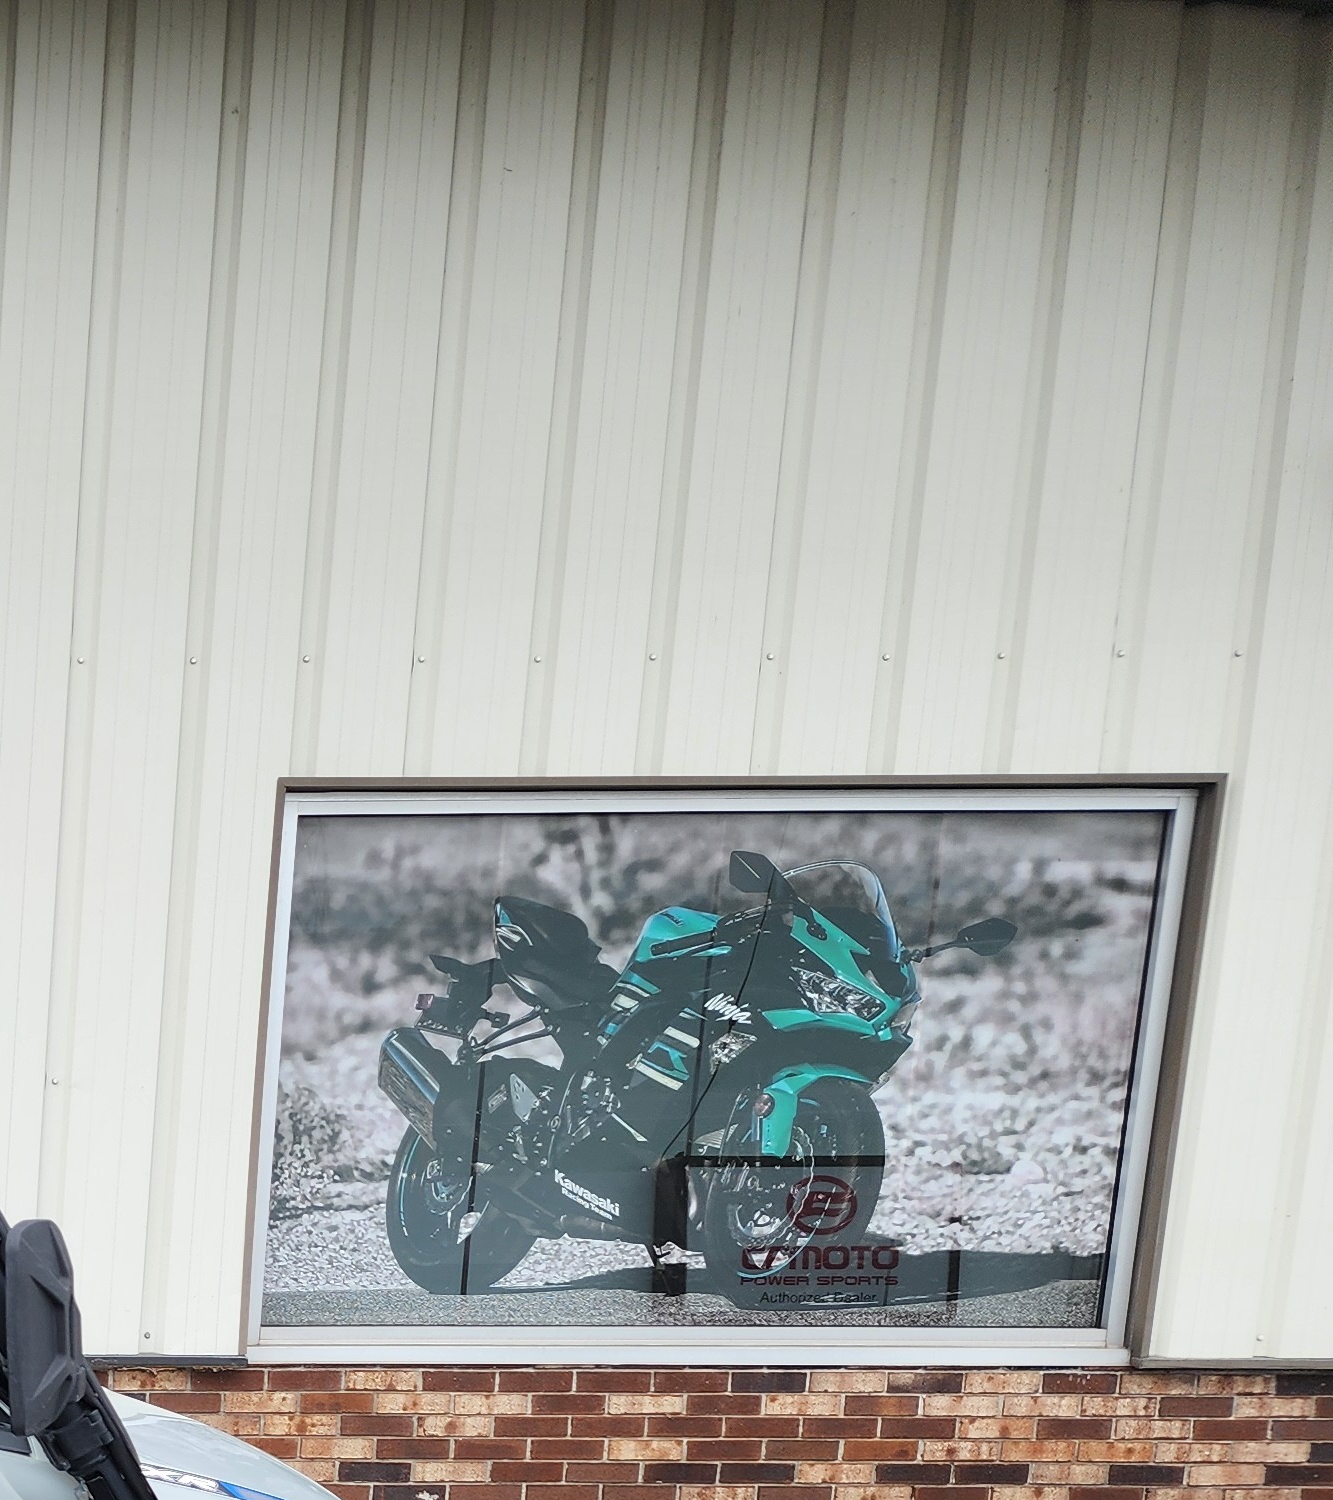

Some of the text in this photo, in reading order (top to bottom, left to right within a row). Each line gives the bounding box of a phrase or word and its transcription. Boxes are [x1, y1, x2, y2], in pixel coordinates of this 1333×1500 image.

[704, 992, 754, 1024] Ninja
[554, 1168, 620, 1217] Kawasaki
[740, 1276, 899, 1286] POWER SPORTS
